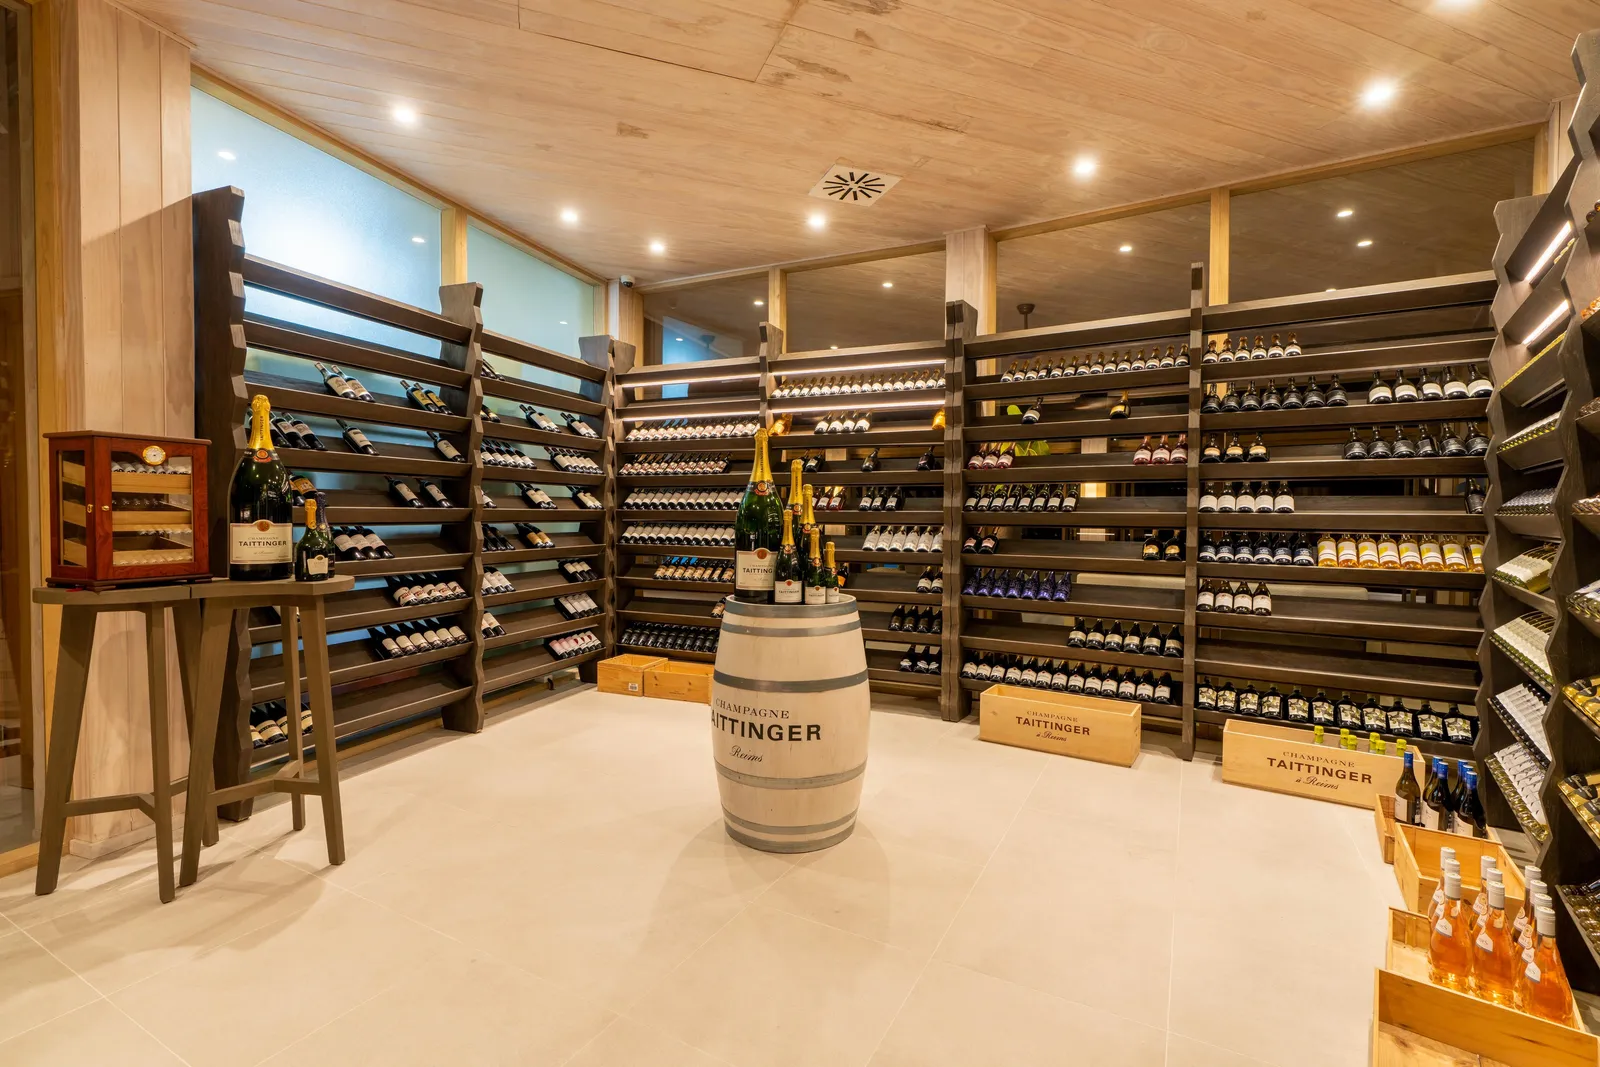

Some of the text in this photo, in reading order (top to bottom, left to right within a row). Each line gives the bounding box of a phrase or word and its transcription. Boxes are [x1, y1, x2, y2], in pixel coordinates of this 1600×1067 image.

[715, 698, 790, 719] CHAMPAGNE
[1026, 710, 1079, 723] CHAMPAGNE
[711, 709, 822, 742] AITTINGER
[1015, 716, 1091, 736] TAITTINGER
[1041, 730, 1068, 742] Reims
[729, 744, 764, 763] Reims
[1282, 751, 1356, 768] CHAMPAGNE
[1266, 757, 1373, 784] TAITTINGER
[1304, 775, 1339, 790] Reims
